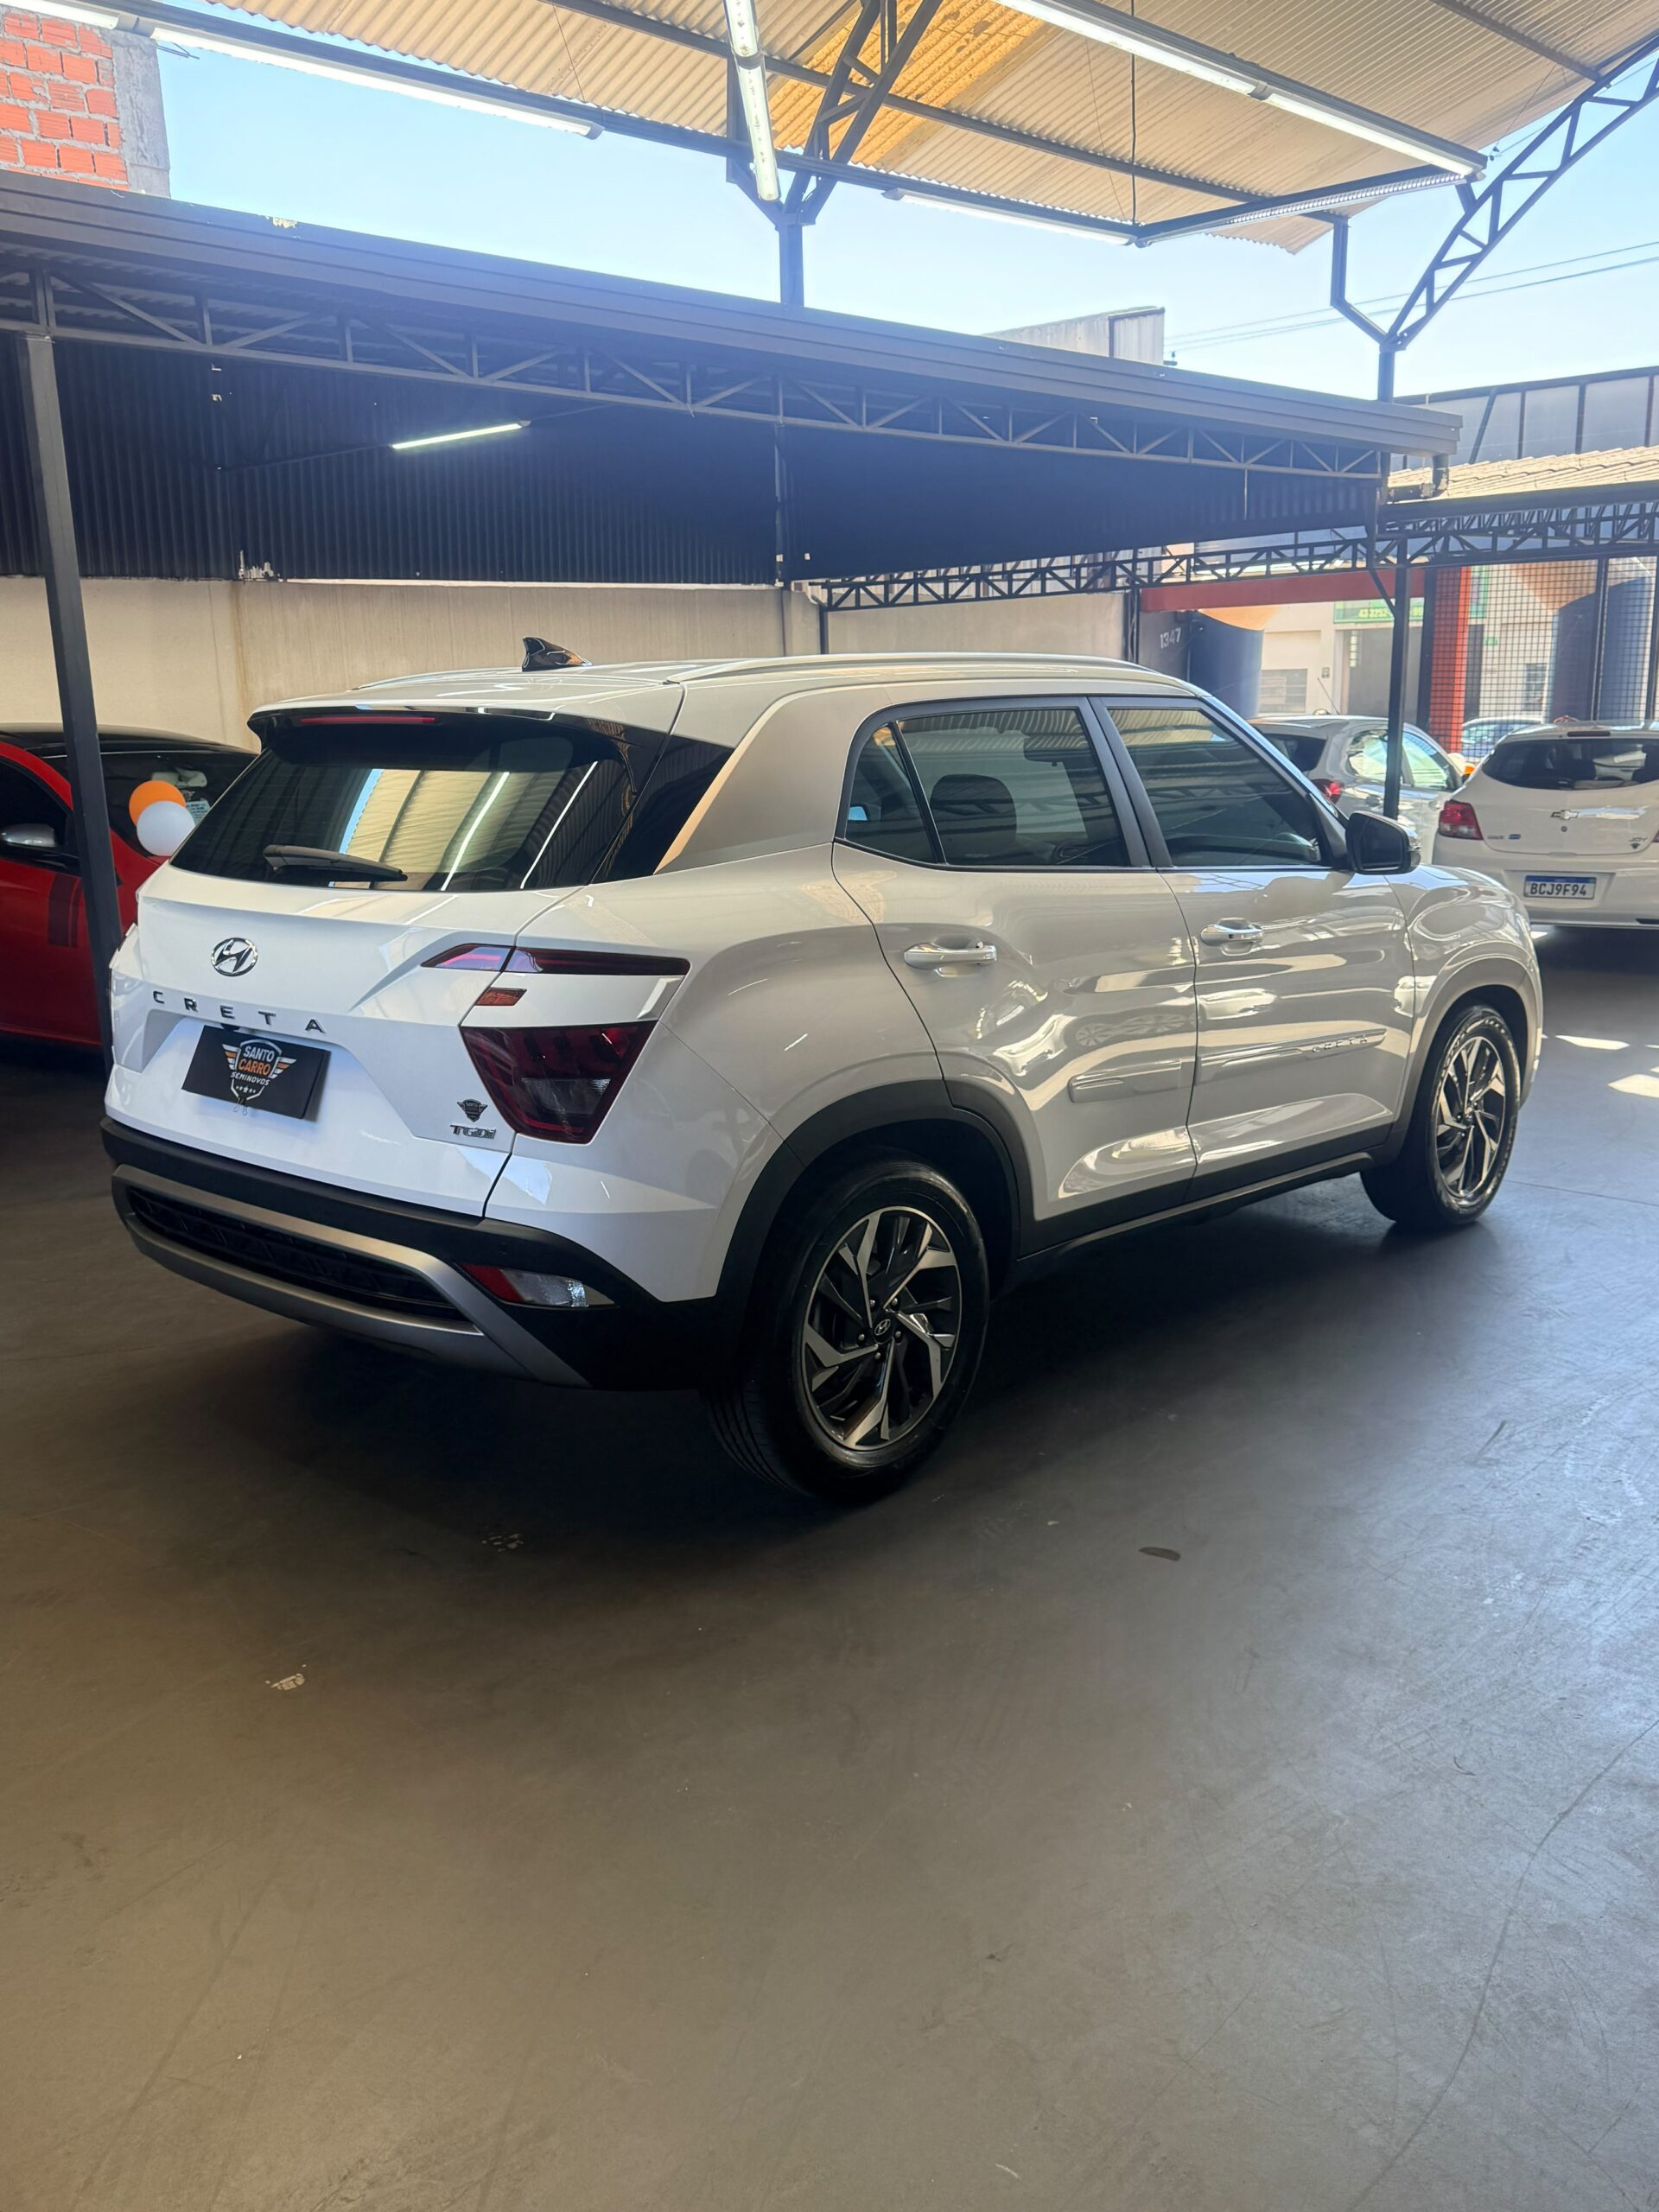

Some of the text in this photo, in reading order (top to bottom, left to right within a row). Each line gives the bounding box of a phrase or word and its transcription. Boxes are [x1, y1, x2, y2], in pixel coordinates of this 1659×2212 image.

[1160, 627, 1182, 649] 1347
[1530, 882, 1586, 896] BCJ9F94
[153, 990, 326, 1034] CRETA
[243, 1045, 275, 1062] SANTO
[238, 1058, 271, 1077] CARRO
[230, 1071, 270, 1086] SEMINOVOS
